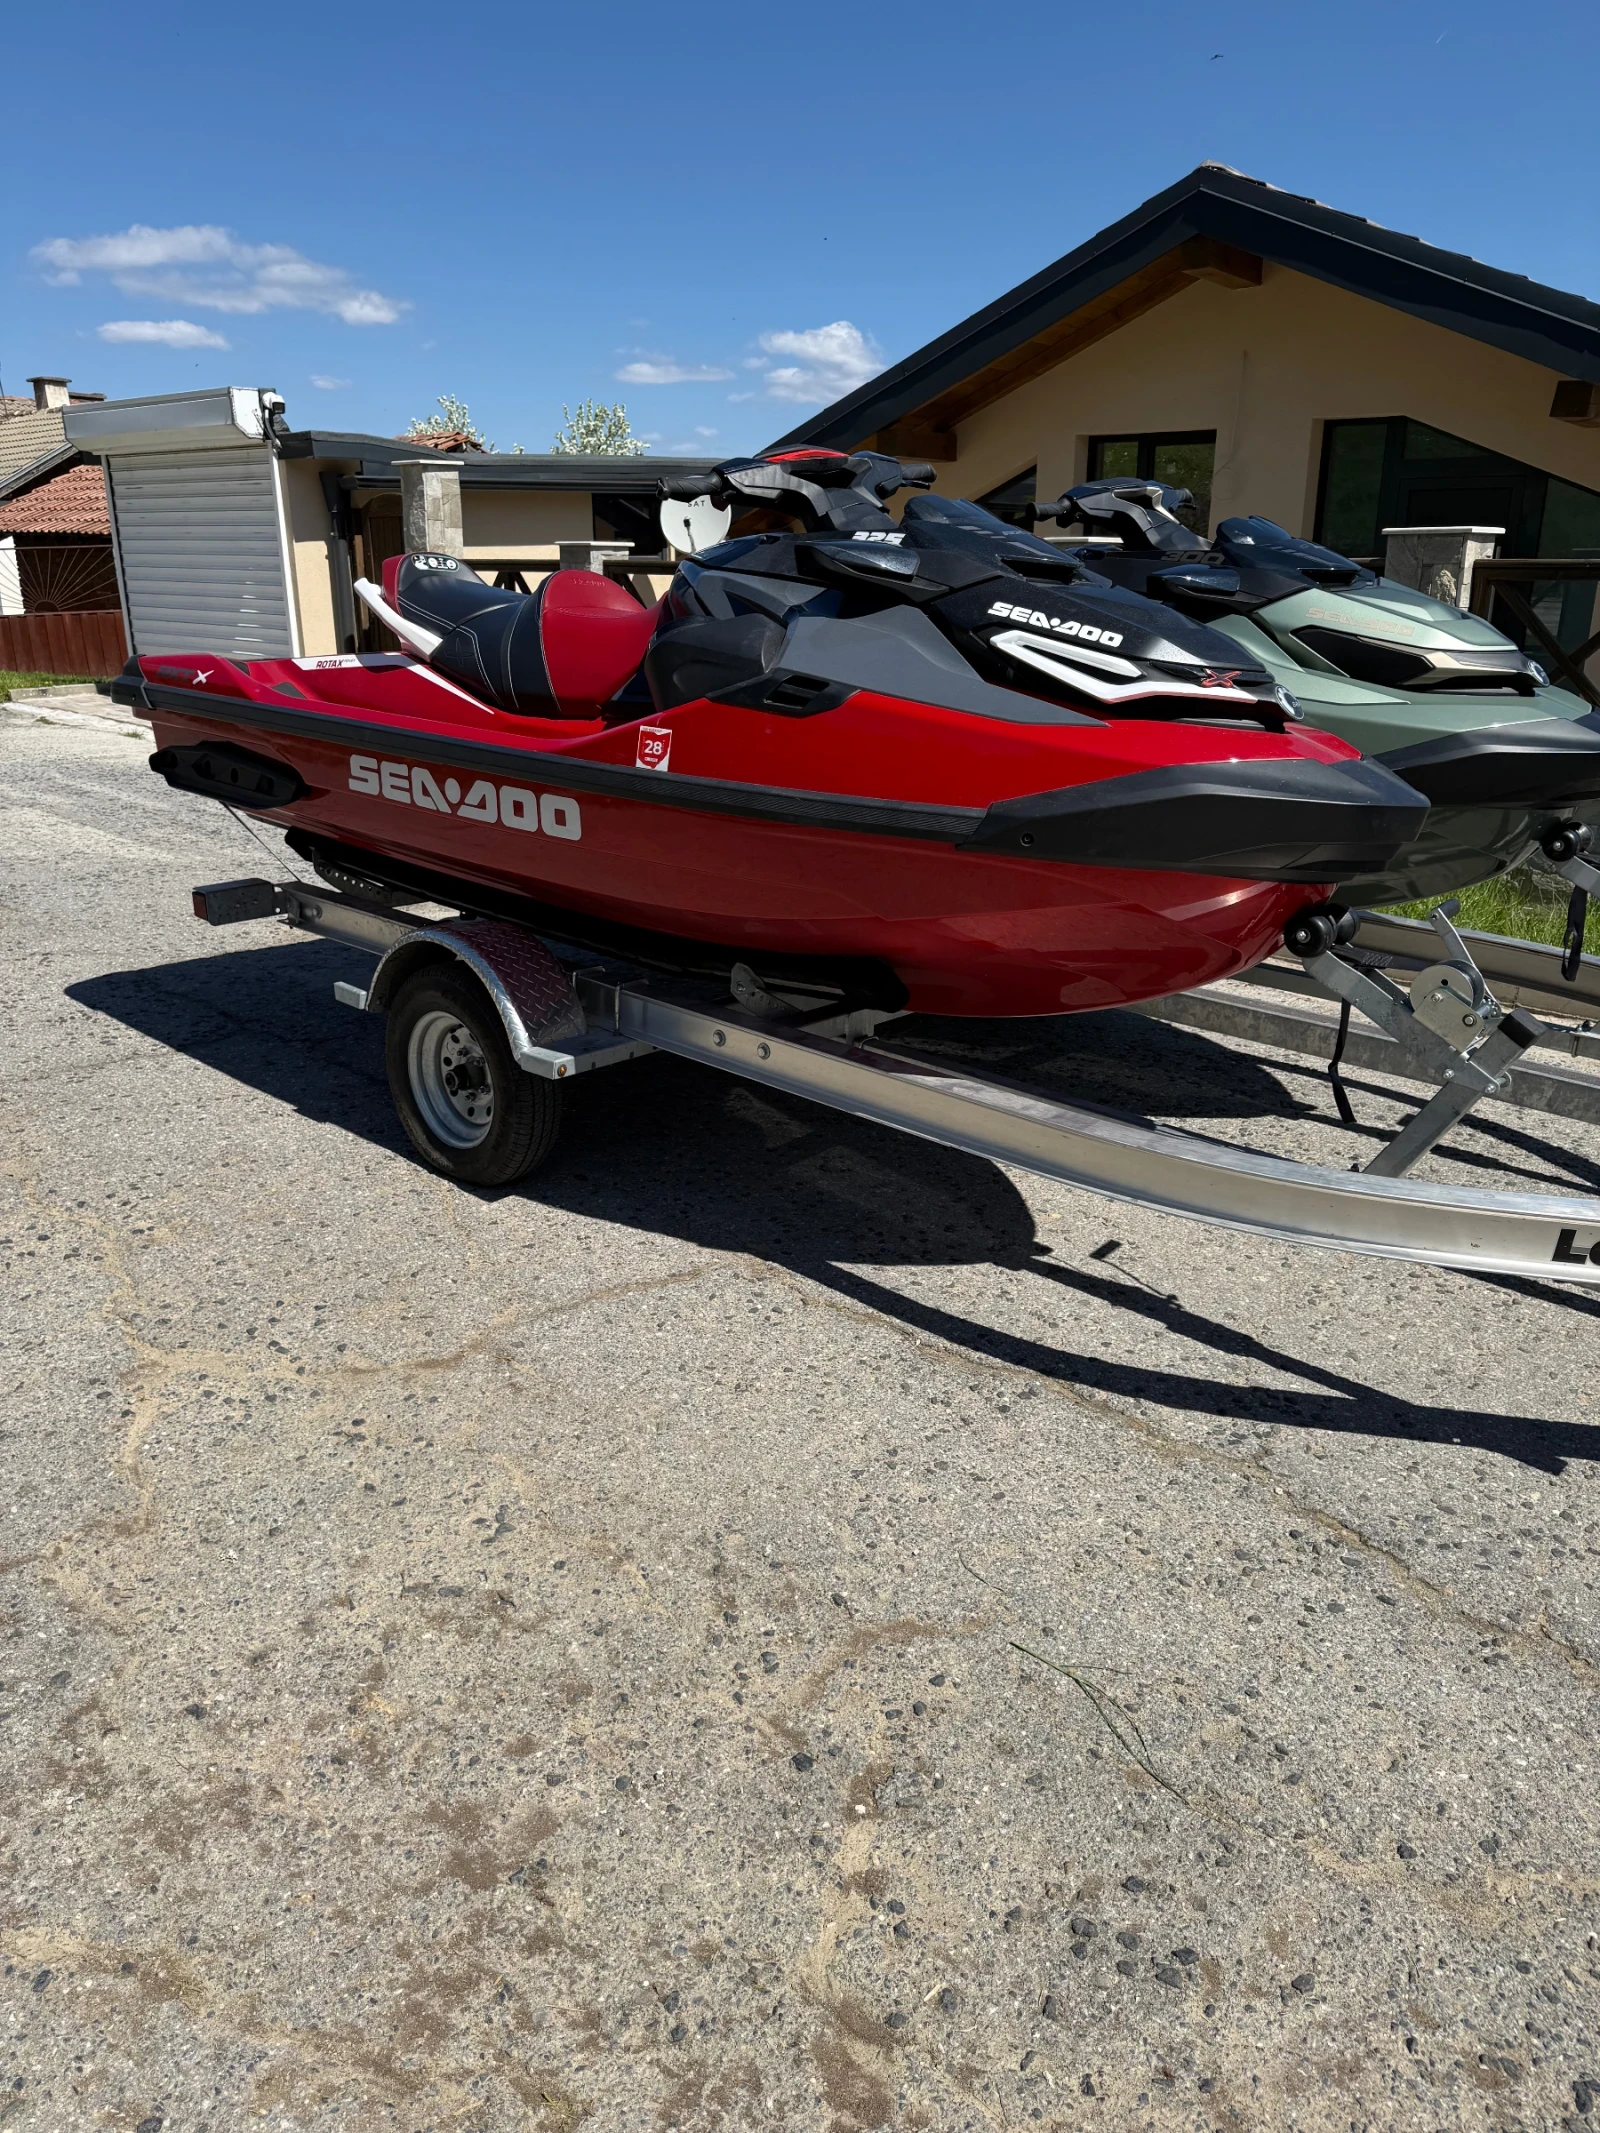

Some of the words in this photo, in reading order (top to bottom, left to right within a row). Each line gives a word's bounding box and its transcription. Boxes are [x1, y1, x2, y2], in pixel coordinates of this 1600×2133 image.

[1160, 551, 1226, 566] 300
[316, 659, 343, 669] ROTAX
[644, 740, 663, 755] 28
